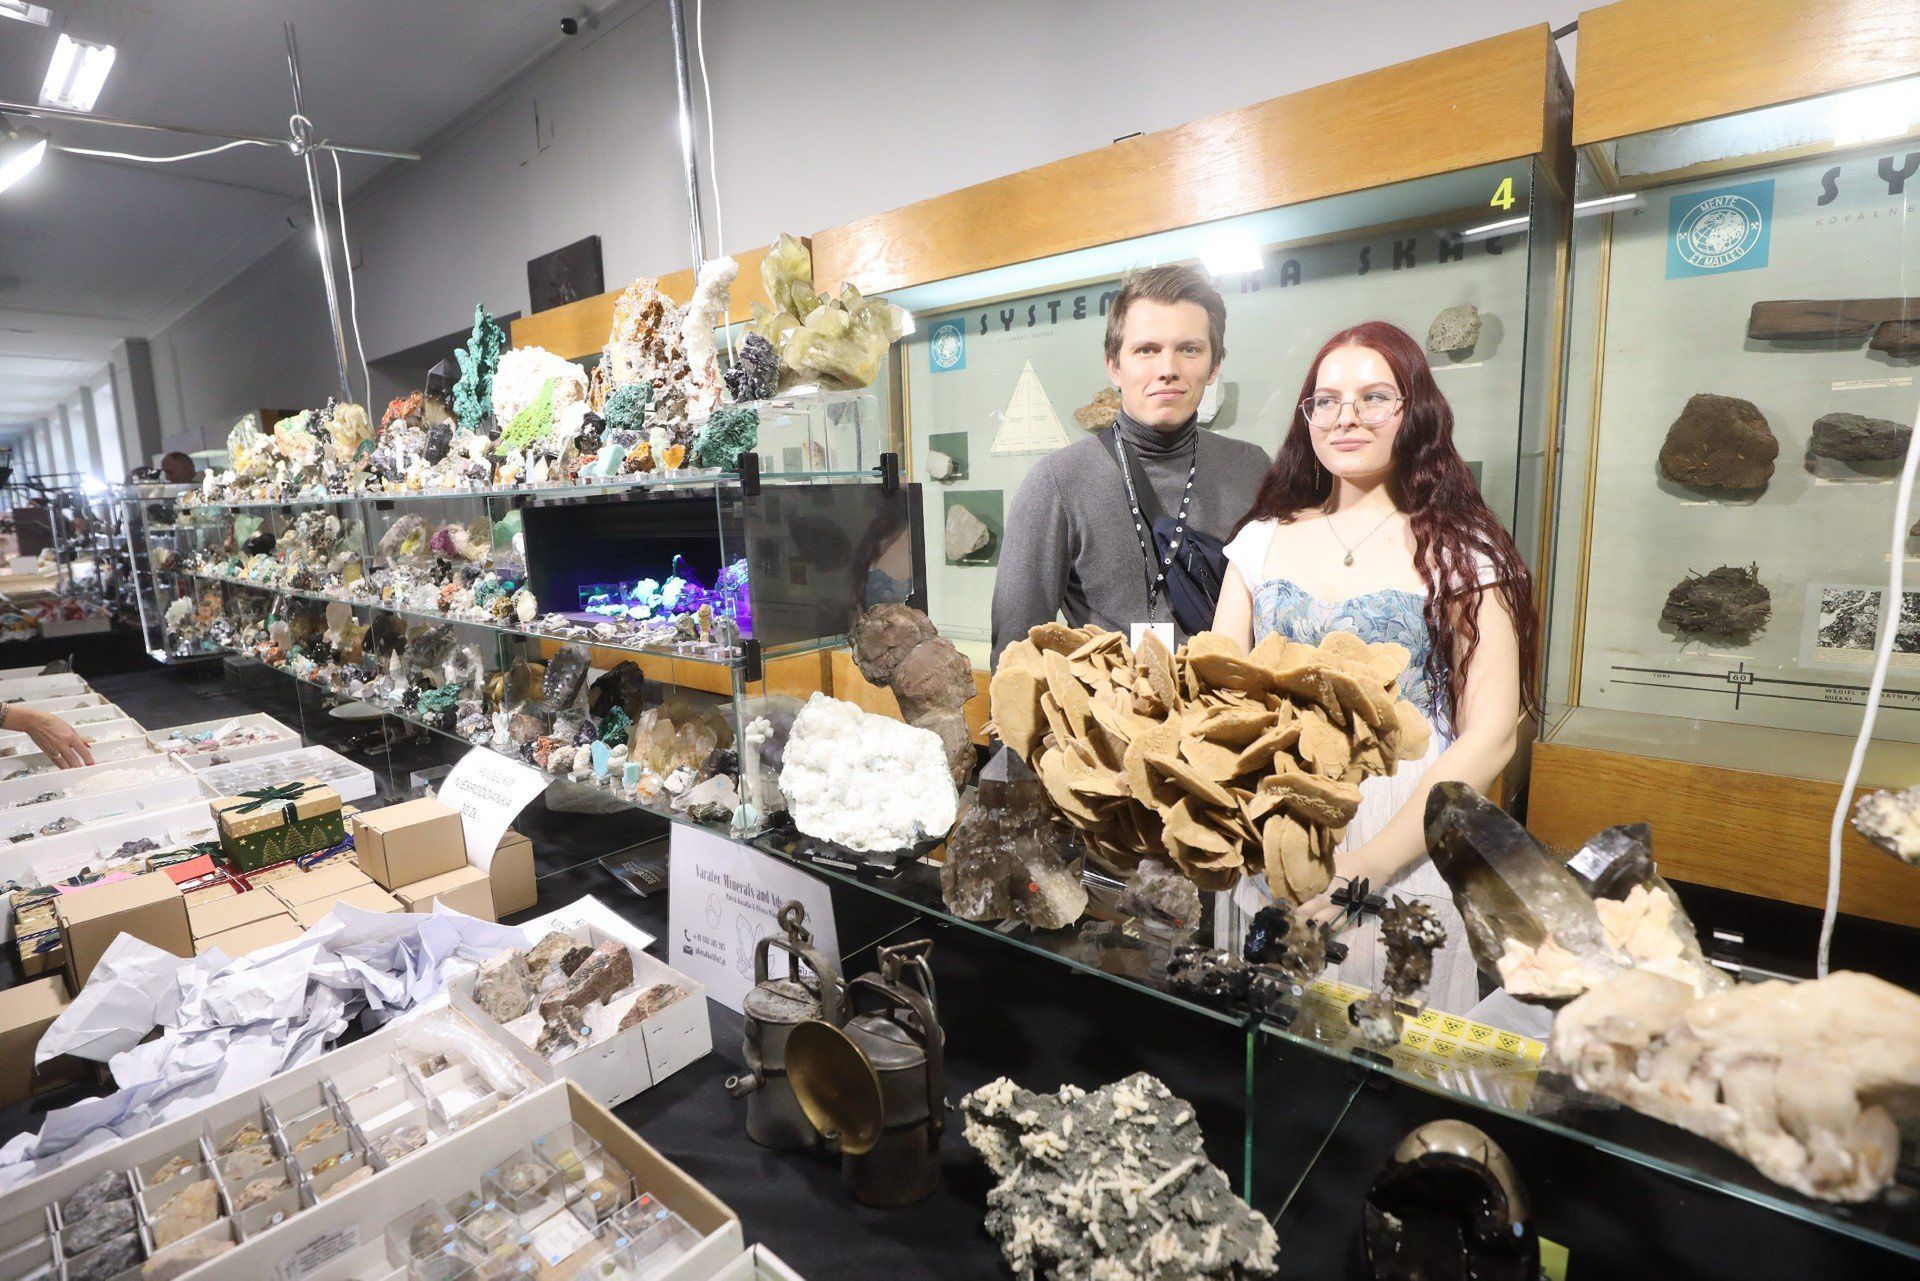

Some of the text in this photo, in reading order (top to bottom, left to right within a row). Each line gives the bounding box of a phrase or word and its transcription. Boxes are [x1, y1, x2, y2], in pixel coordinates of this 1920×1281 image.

[1490, 177, 1516, 211] 4
[1699, 194, 1740, 213] MENTE
[1703, 246, 1746, 268] MALLEO
[1732, 674, 1748, 682] 60
[723, 873, 755, 899] Minerals
[756, 889, 770, 904] and
